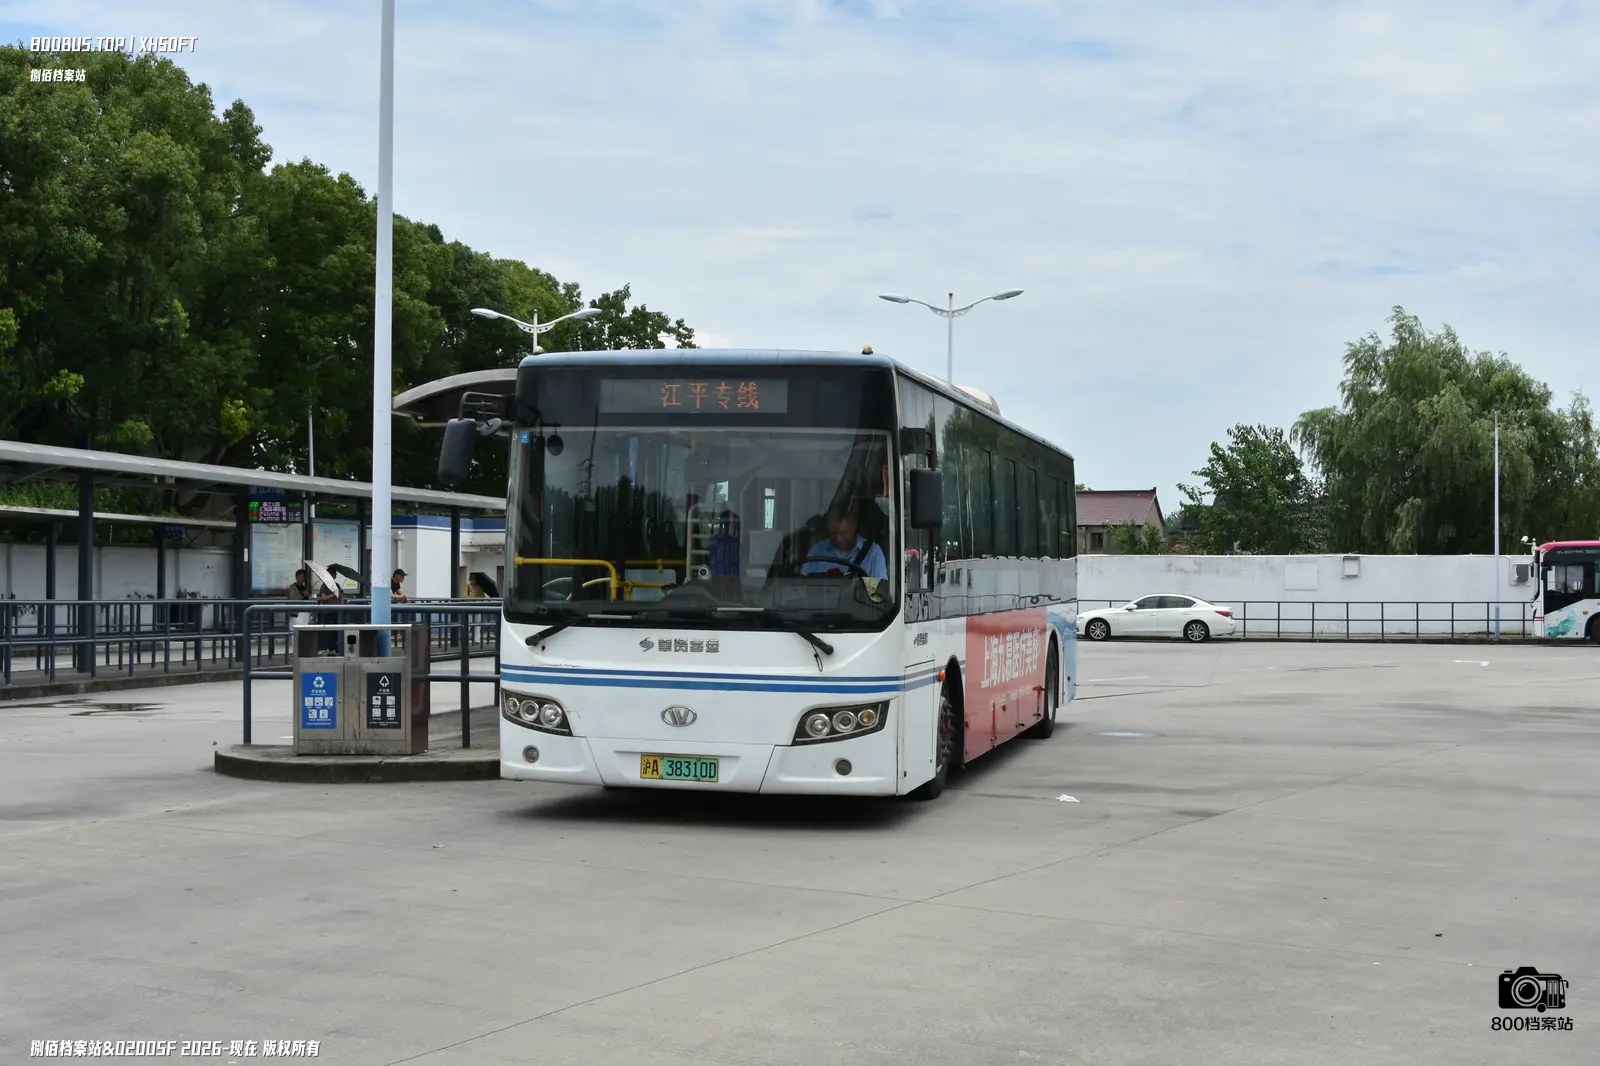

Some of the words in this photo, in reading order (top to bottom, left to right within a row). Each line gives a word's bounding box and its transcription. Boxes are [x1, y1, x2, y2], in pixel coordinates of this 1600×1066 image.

[660, 380, 760, 410] 江平专线
[642, 759, 659, 776] 沪A
[665, 760, 717, 779] 38310D
